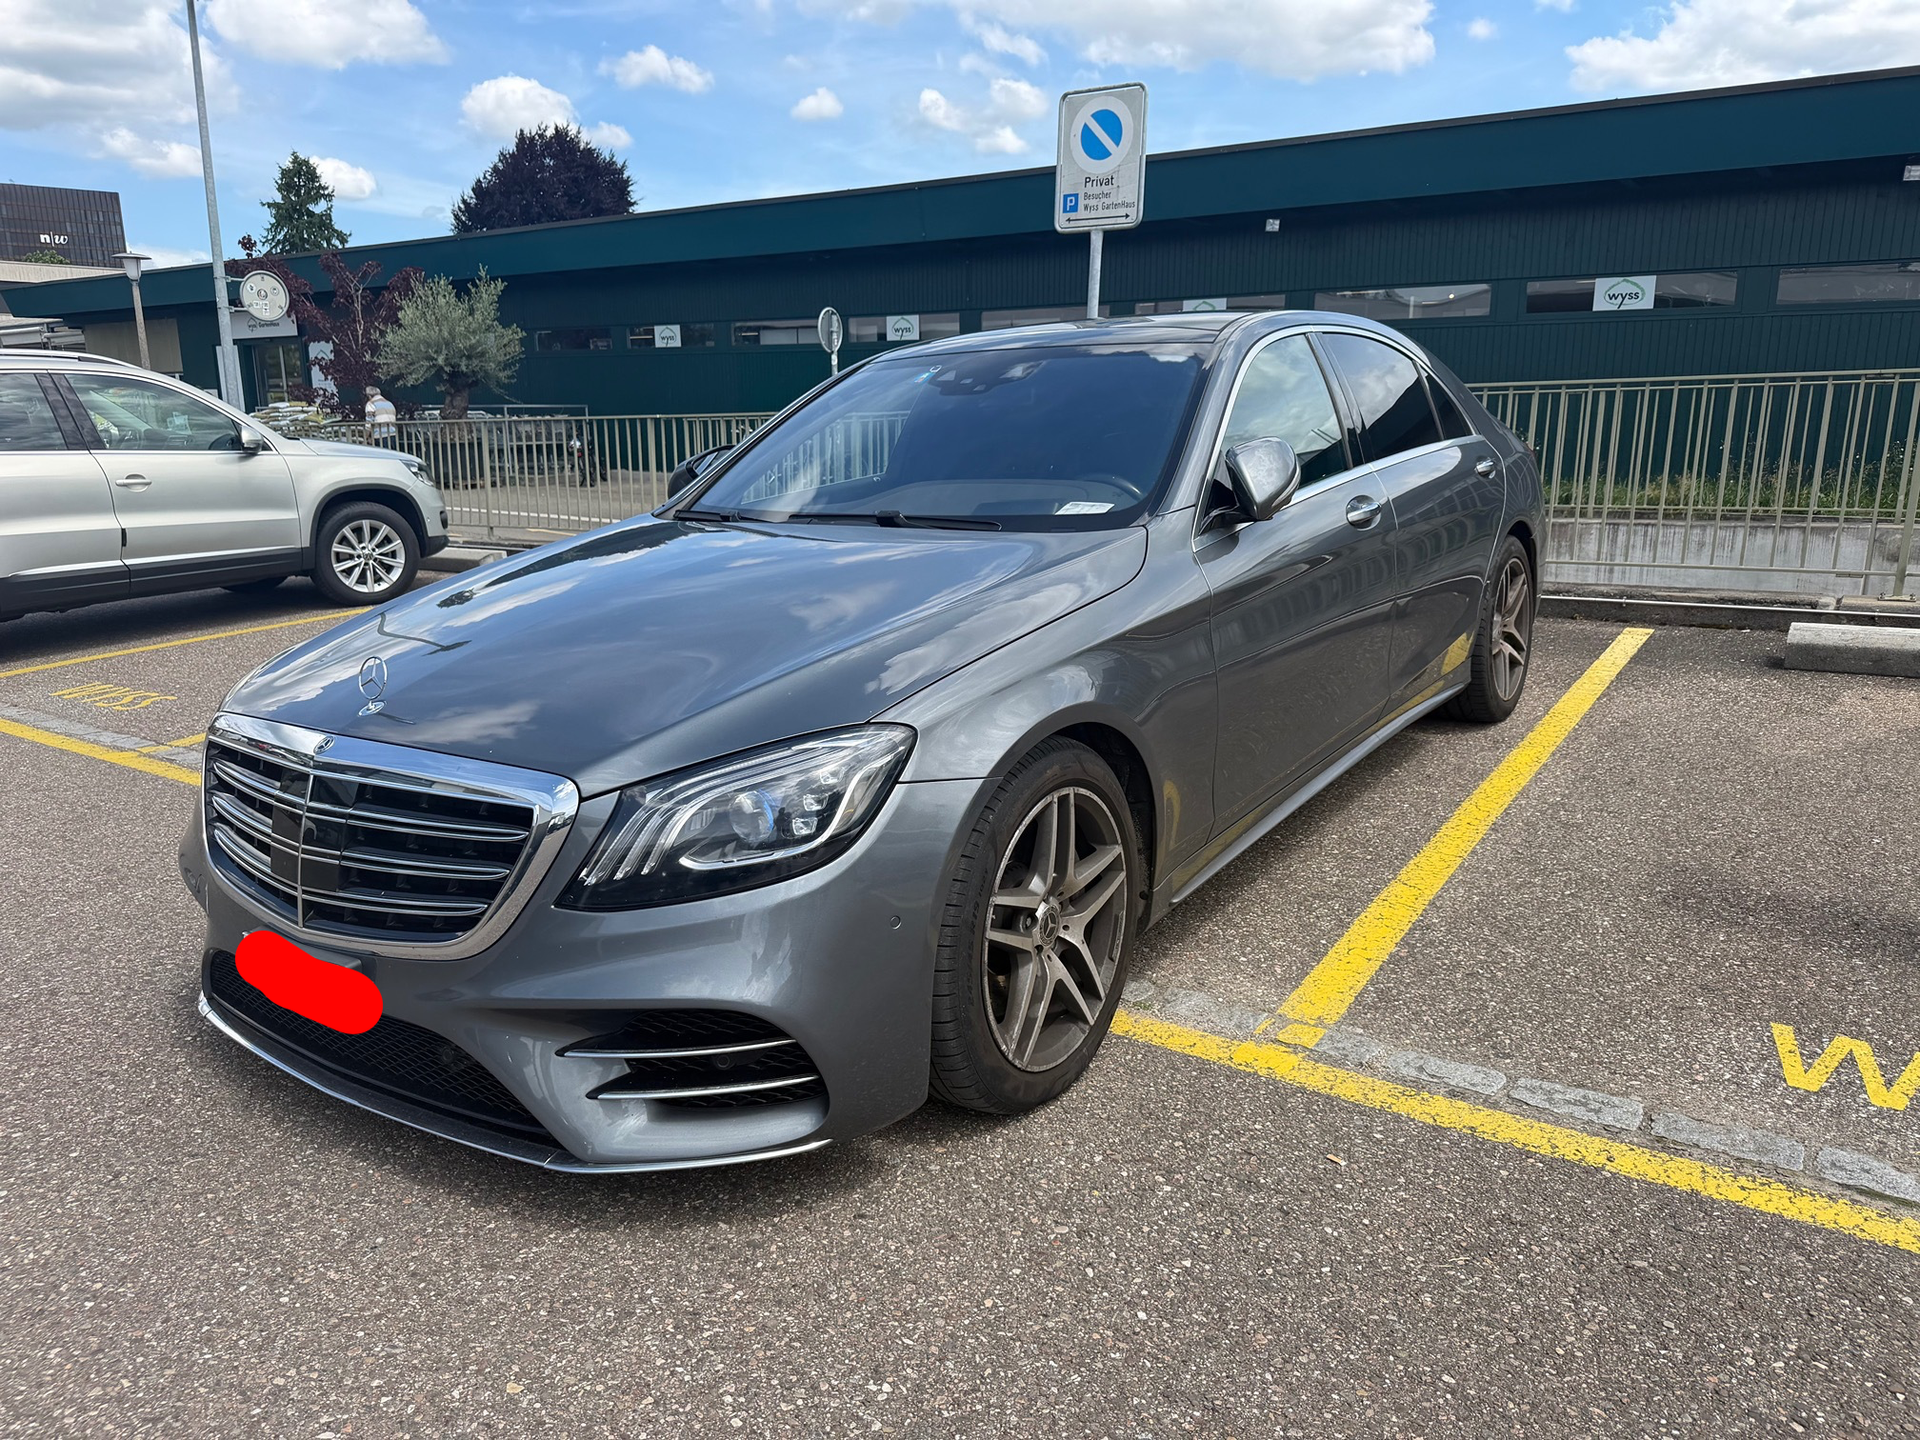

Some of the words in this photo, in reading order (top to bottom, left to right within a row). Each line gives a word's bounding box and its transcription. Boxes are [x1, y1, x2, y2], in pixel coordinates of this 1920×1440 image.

[1084, 175, 1115, 188] Privat
[1083, 190, 1112, 200] Besucher
[1066, 196, 1075, 211] P
[1083, 203, 1099, 213] Wyss
[1101, 200, 1136, 211] GartenHaus
[1607, 291, 1640, 310] wyss
